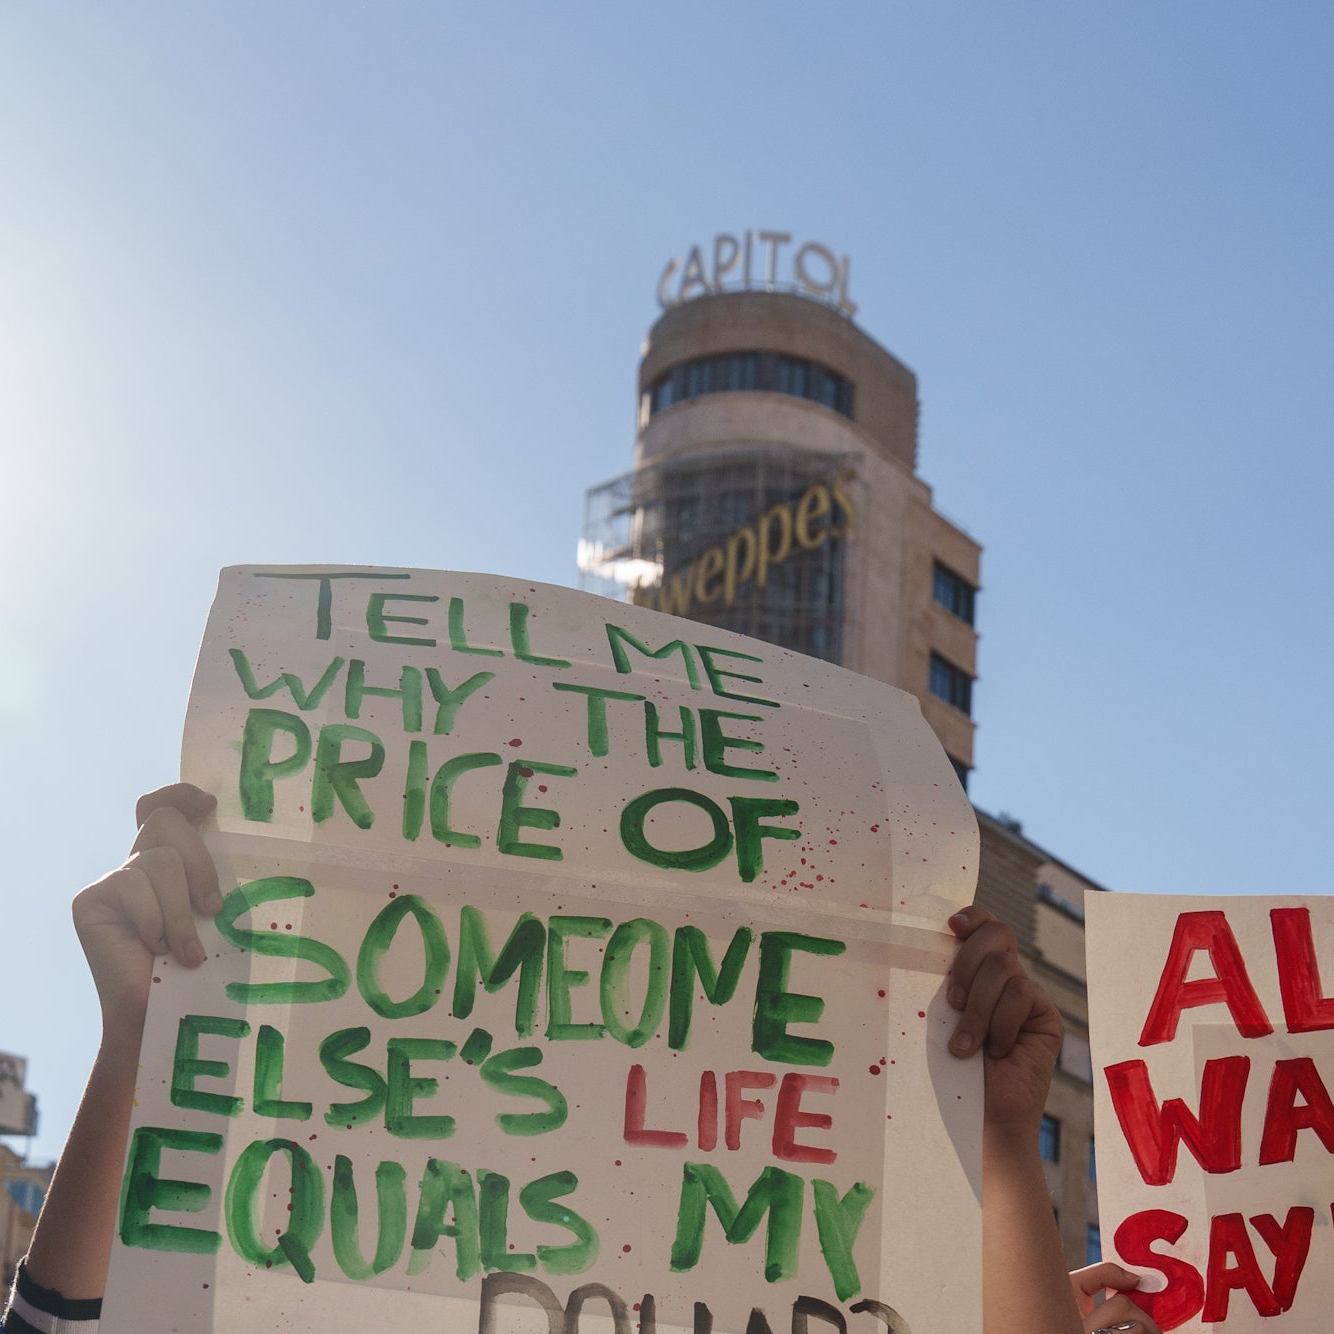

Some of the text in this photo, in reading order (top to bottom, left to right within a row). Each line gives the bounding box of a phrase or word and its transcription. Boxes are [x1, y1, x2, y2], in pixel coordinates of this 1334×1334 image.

[657, 229, 857, 316] CAPITOL
[252, 572, 781, 708] TELL ME
[227, 648, 781, 782] WHY THE
[238, 708, 801, 883] PRICE OF
[214, 876, 847, 1067] SOMEONE
[170, 1014, 841, 1164] ELSE'S LIFE
[118, 1126, 875, 1302] EQUALS MY
[1113, 1206, 1317, 1332] SAY
